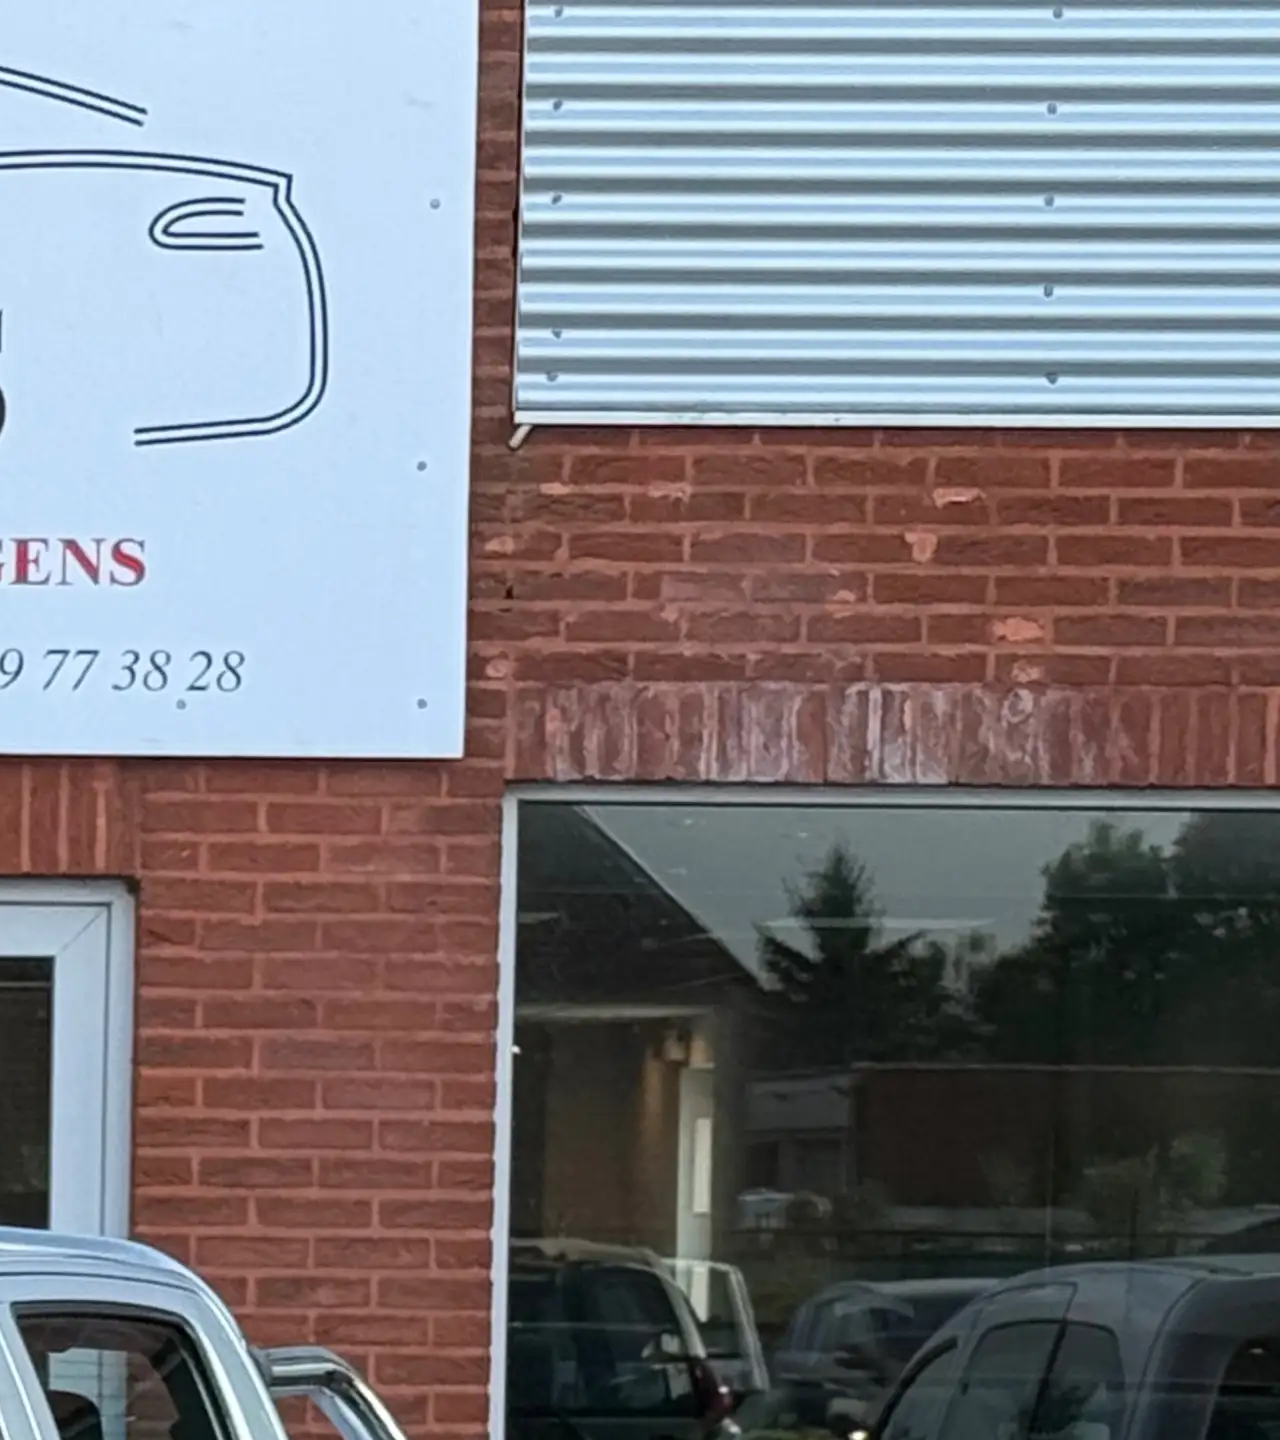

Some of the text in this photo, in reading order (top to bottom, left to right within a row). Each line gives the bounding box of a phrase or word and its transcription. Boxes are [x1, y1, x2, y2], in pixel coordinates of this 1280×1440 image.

[42, 648, 101, 691] 77
[111, 649, 172, 692] 38
[185, 650, 246, 692] 28
